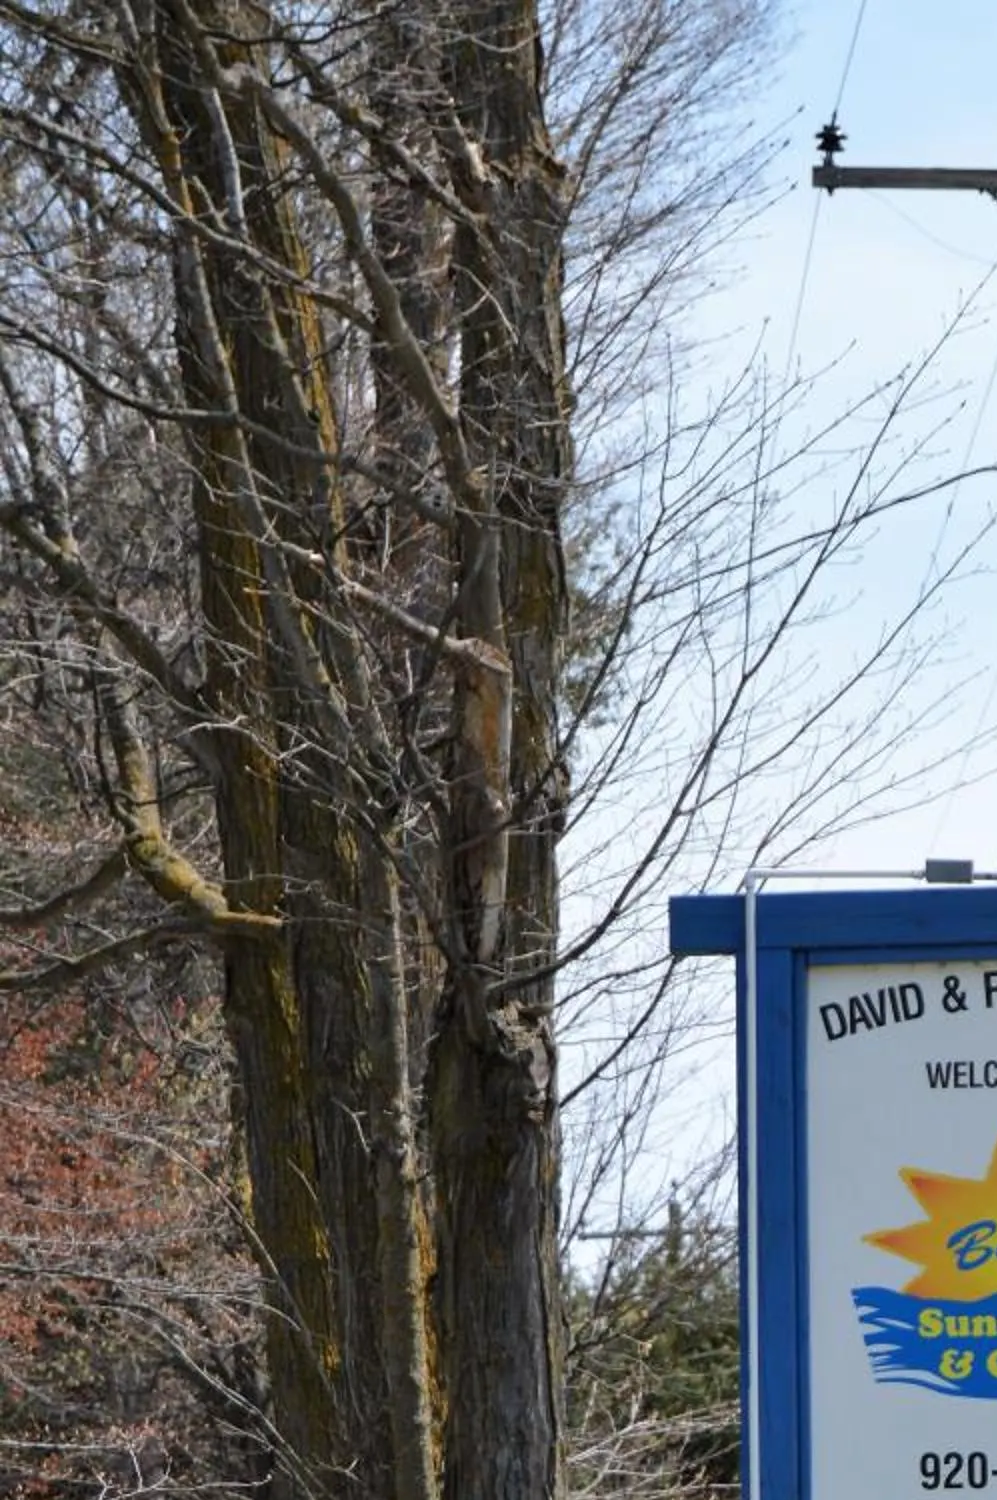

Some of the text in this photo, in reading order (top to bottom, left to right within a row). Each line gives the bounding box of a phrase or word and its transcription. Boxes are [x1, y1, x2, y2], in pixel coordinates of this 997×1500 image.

[819, 981, 925, 1041] DAVID
[942, 975, 968, 1013] &
[939, 1349, 974, 1378] &
